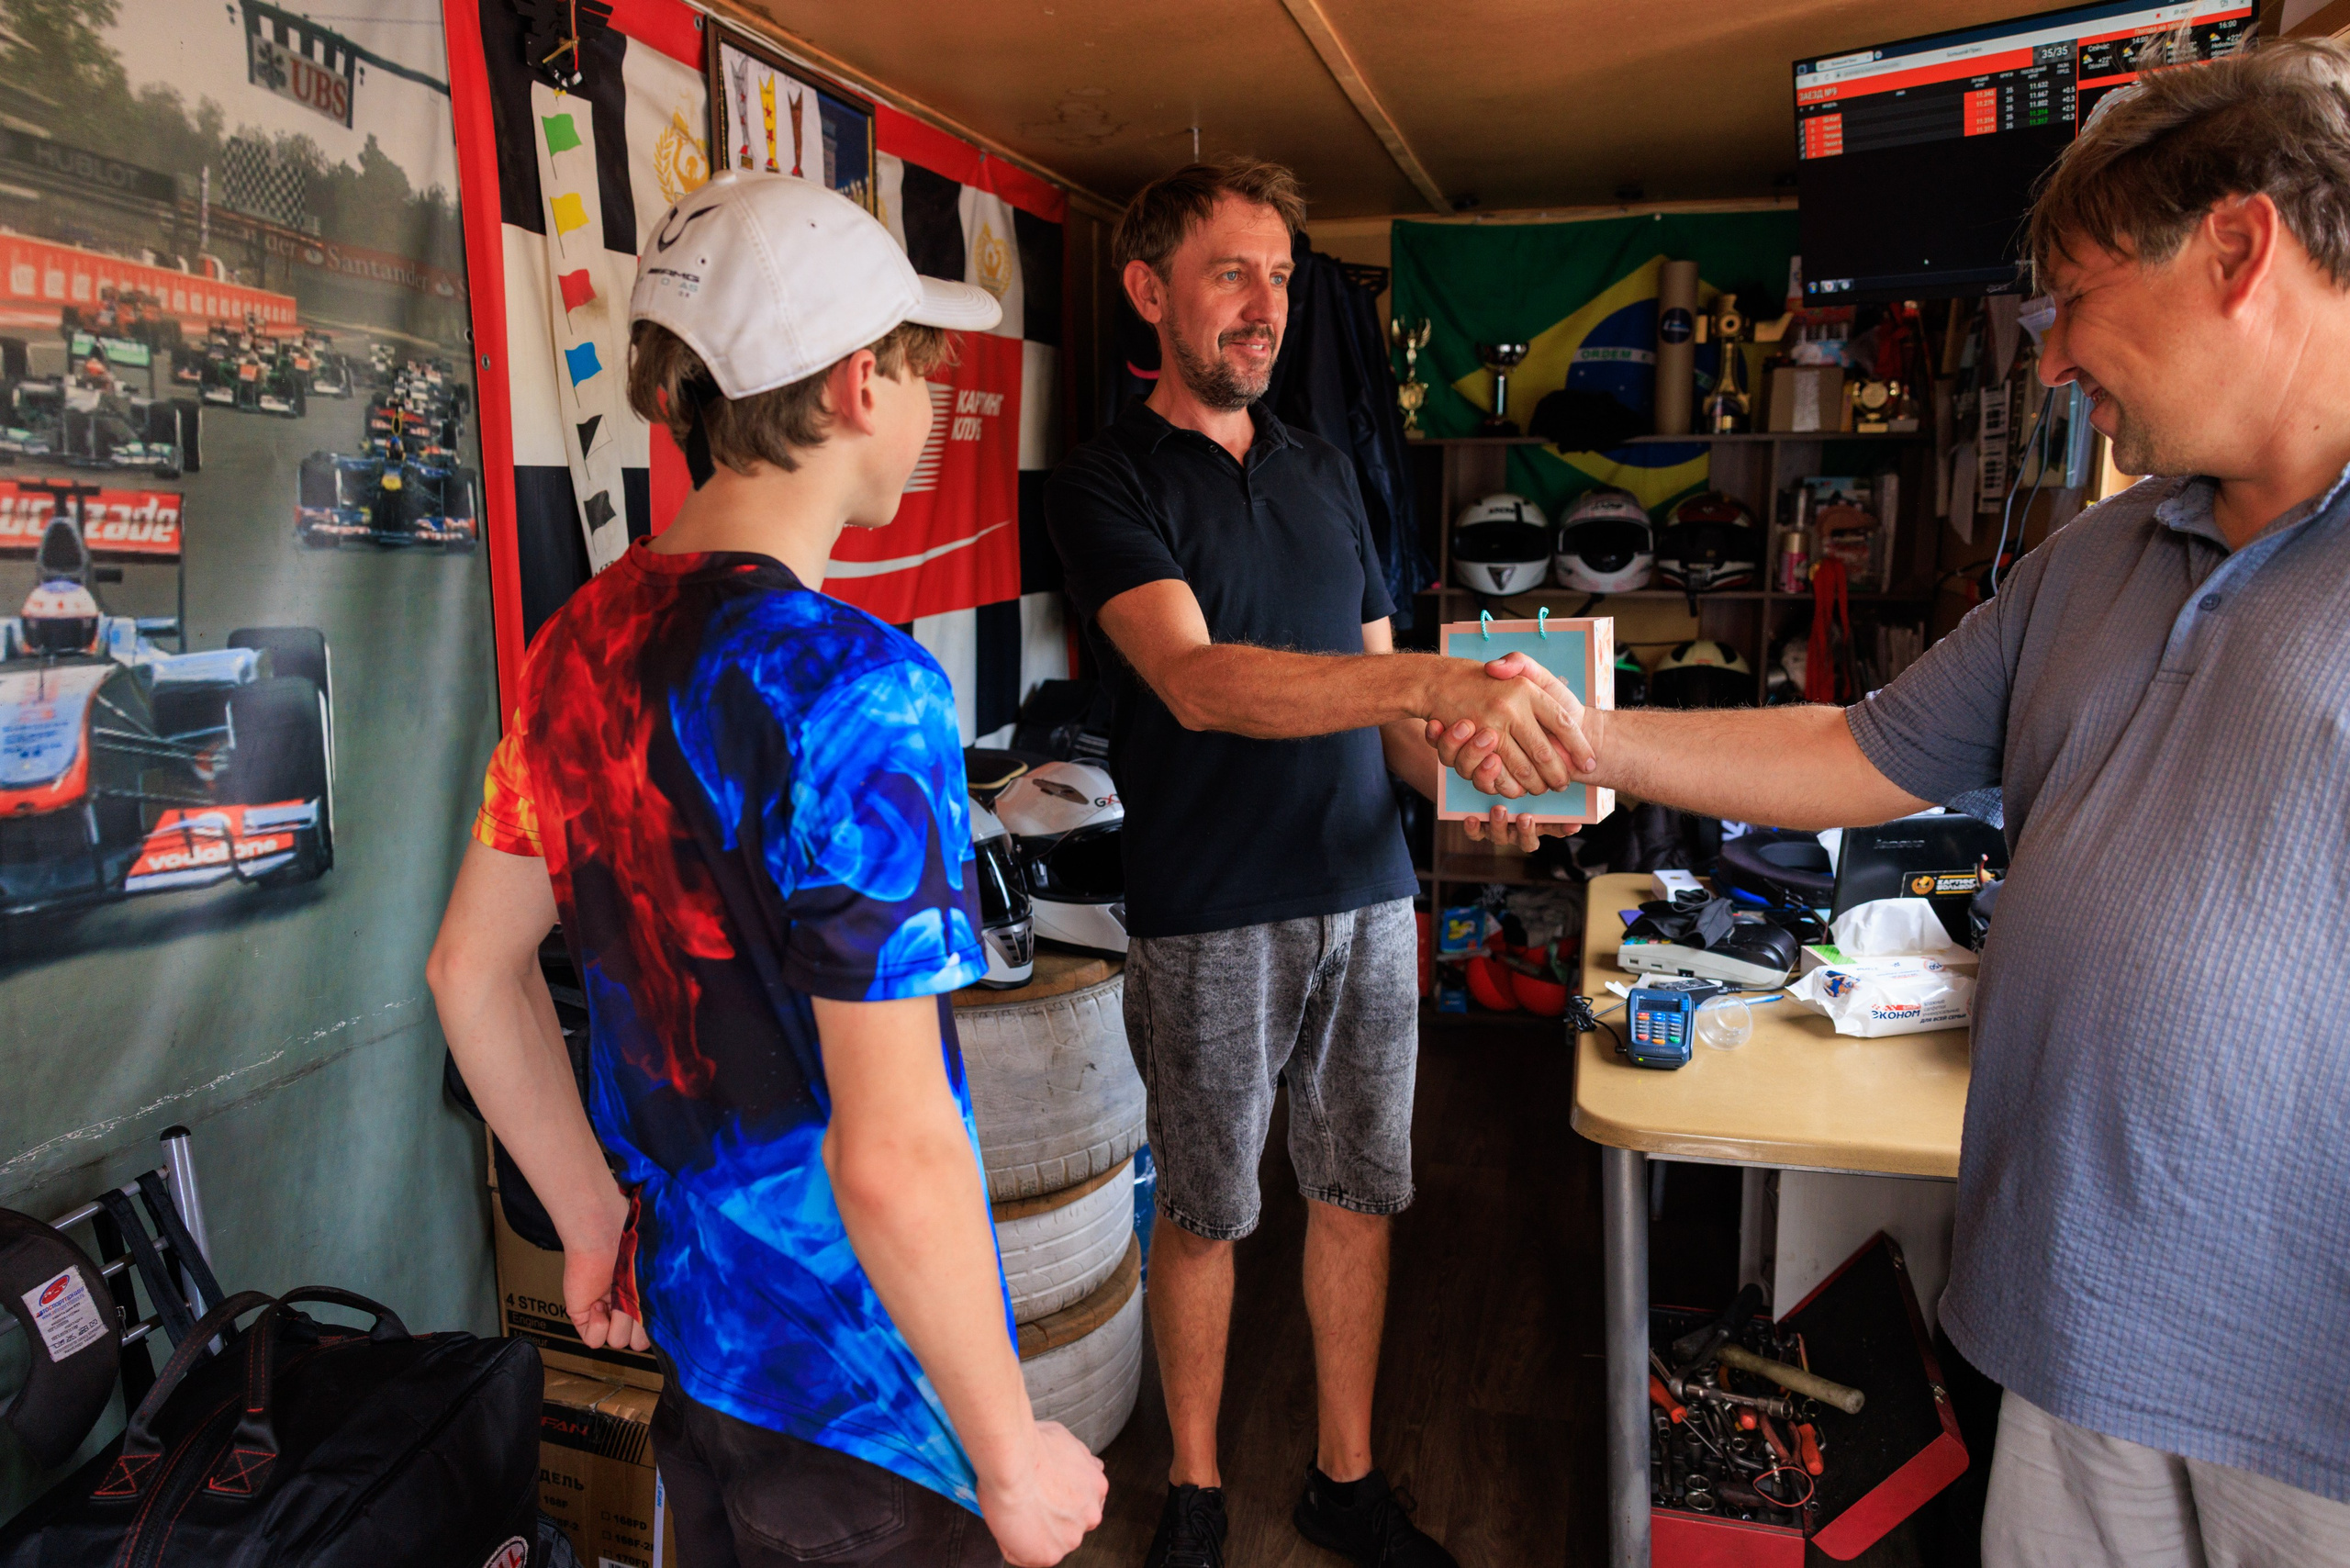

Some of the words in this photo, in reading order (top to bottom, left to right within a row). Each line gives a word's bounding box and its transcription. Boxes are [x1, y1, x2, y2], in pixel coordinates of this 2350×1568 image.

[2219, 19, 2237, 29] 16:00
[2041, 46, 2069, 60] 35/35
[291, 58, 347, 120] UBS
[1798, 89, 1824, 102] ЗАЕЗД
[328, 243, 429, 291] Santander
[1581, 349, 1632, 360] ORDEM
[955, 389, 1005, 417] КАРТИНГ
[148, 838, 278, 870] vodafone
[1871, 1010, 1920, 1021] ЭКОНОМ
[506, 1293, 515, 1307] 4
[512, 1313, 546, 1330] Engine
[543, 1495, 568, 1509] 168F
[613, 1513, 648, 1531] 168FD
